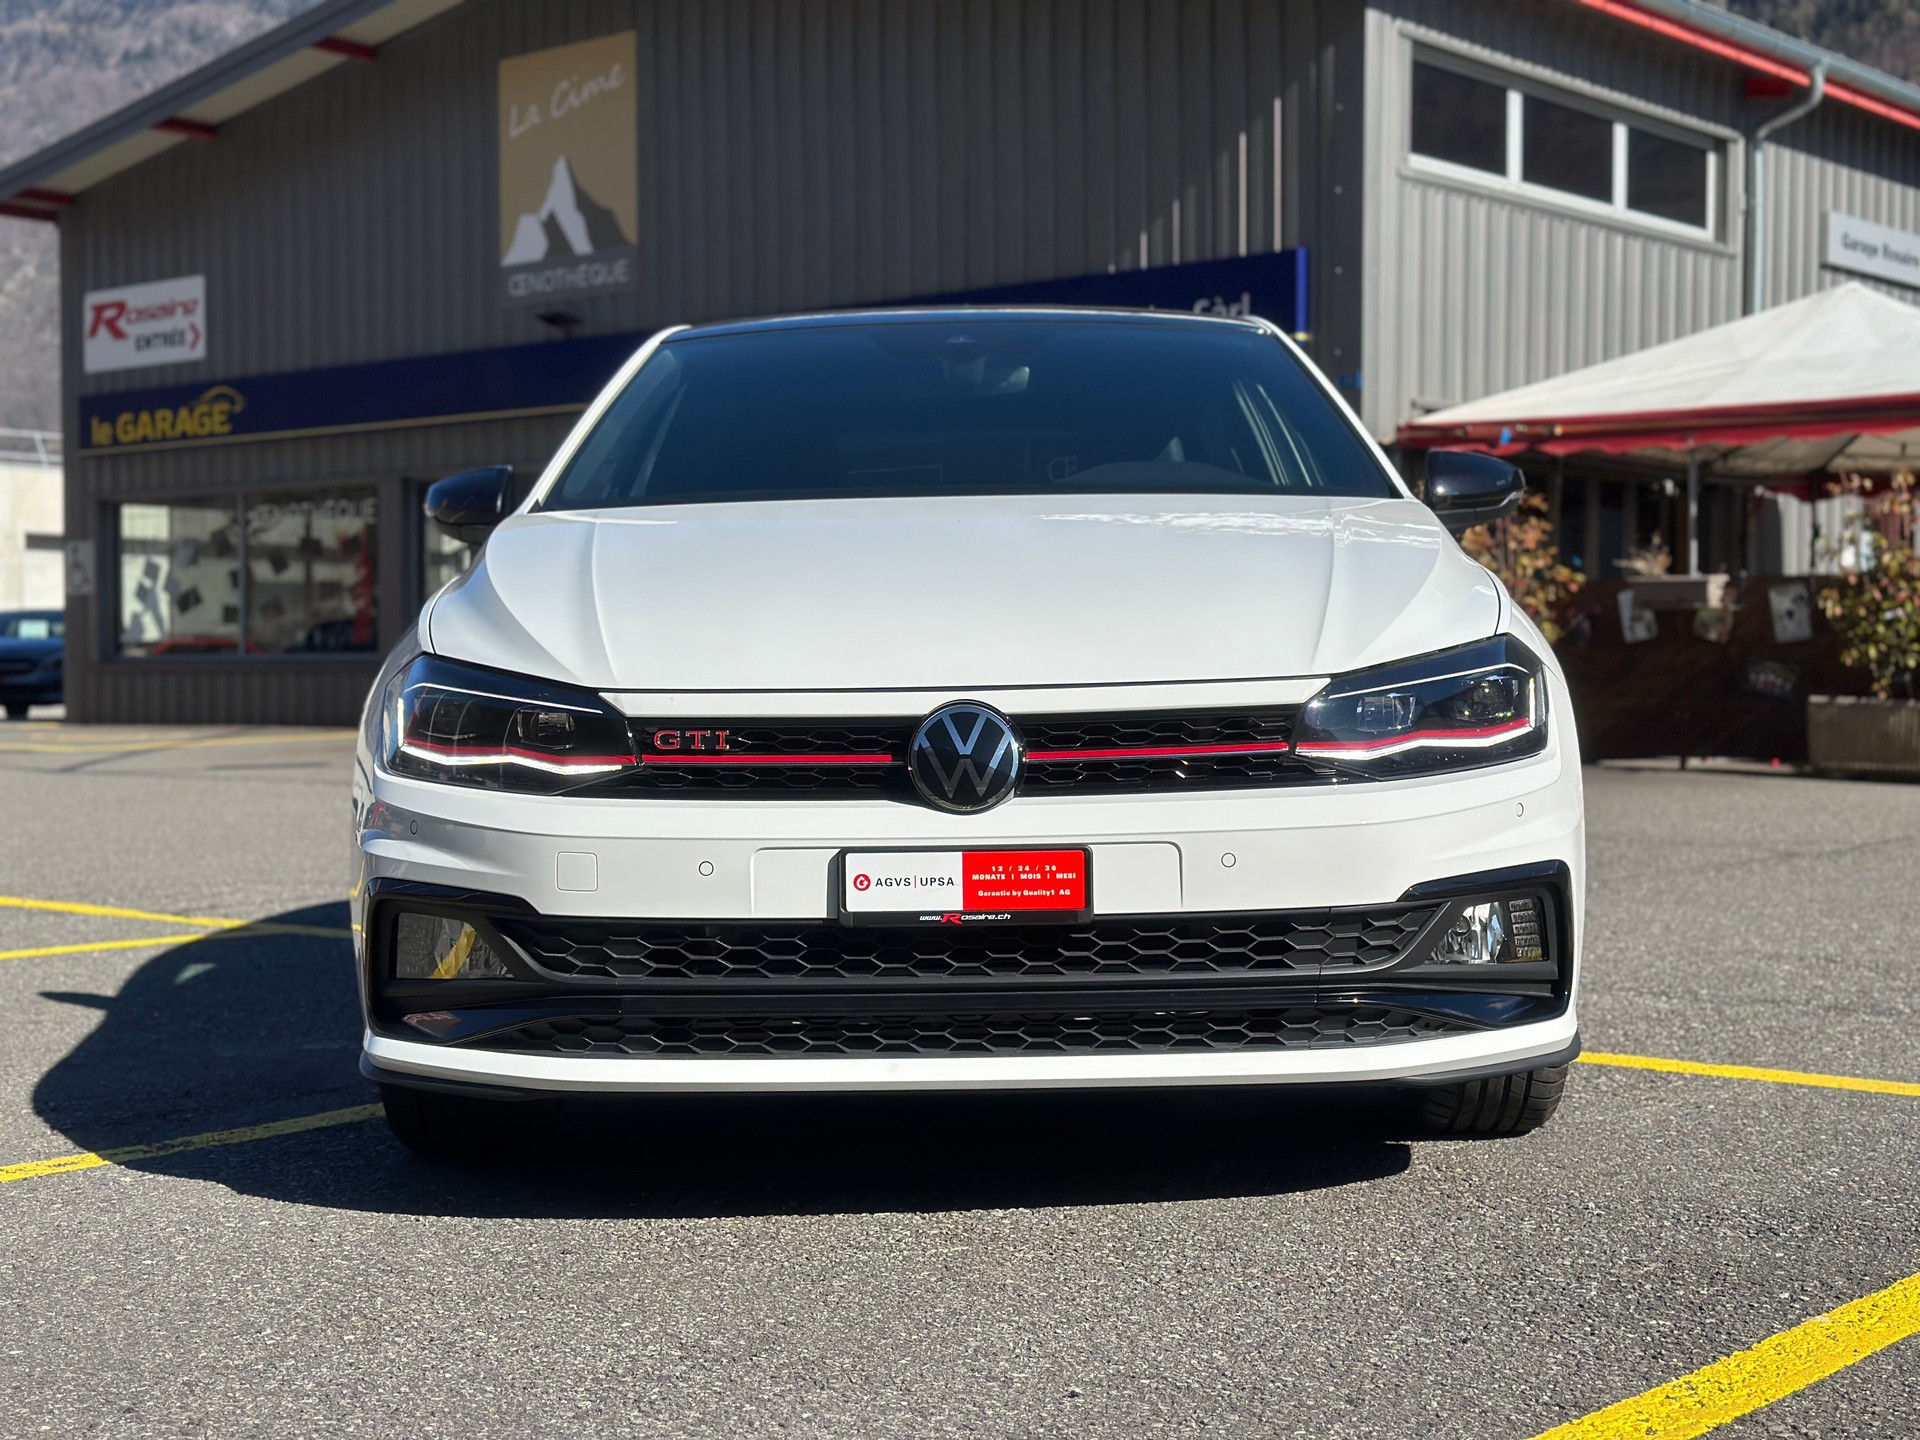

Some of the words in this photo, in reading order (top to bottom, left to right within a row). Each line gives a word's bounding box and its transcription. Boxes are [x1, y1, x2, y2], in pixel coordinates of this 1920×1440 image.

[508, 104, 542, 138] La
[550, 63, 624, 119] Cime
[91, 416, 113, 446] le
[115, 401, 232, 443] GARAGE
[653, 730, 730, 750] GTI
[991, 864, 1004, 872] 12
[1044, 864, 1057, 872] 36
[875, 877, 912, 888] AGVS
[919, 876, 955, 887] UPSA
[972, 873, 1006, 881] MONATE
[1056, 872, 1077, 880] MESI
[1012, 889, 1022, 898] by
